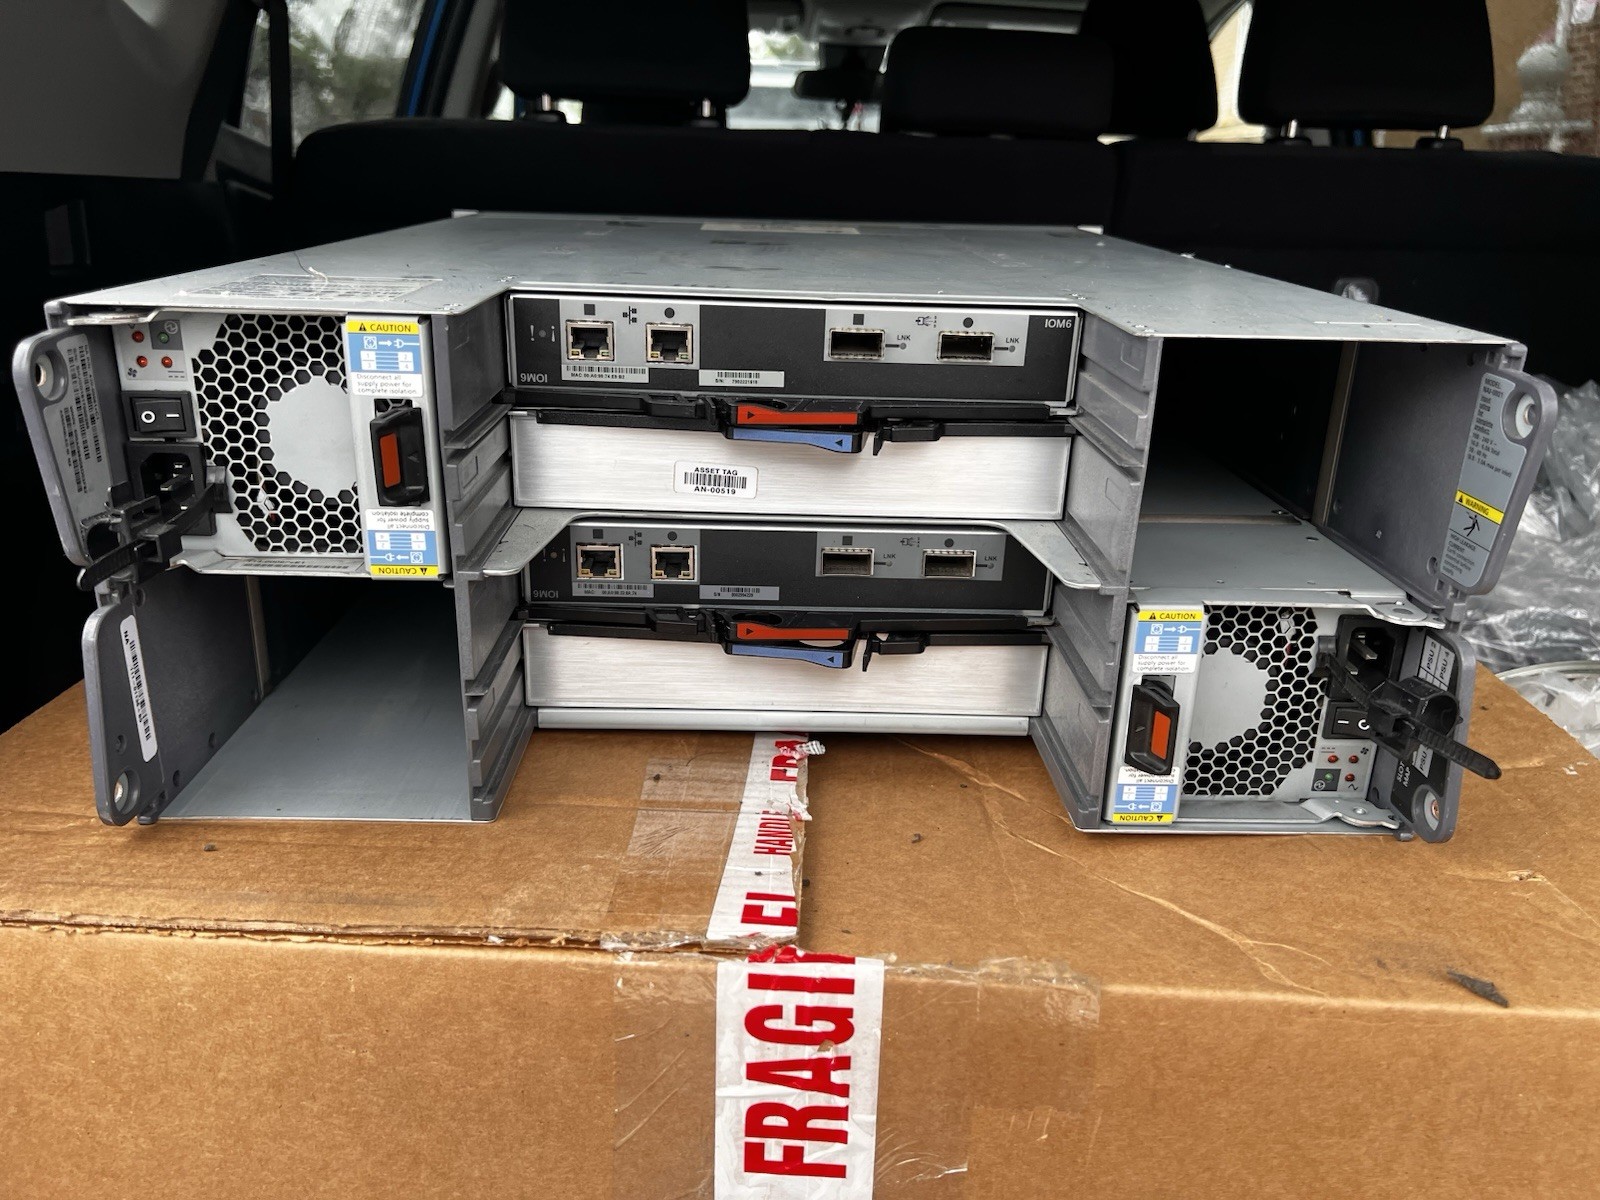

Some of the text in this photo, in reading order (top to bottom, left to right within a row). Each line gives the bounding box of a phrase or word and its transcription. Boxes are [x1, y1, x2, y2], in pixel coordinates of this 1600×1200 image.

[369, 324, 411, 332] CAUTION
[1044, 318, 1072, 329] IOM6
[520, 372, 548, 383] IOM6
[694, 486, 736, 495] AN-00519
[1465, 498, 1489, 515] WARNING
[378, 567, 417, 575] CAUTION
[533, 589, 559, 599] IOM6
[1426, 641, 1436, 670] PSU 2
[1440, 658, 1448, 680] PSU
[1419, 750, 1428, 771] PSU
[1397, 760, 1405, 782] SLOT
[1403, 766, 1411, 787] MAP
